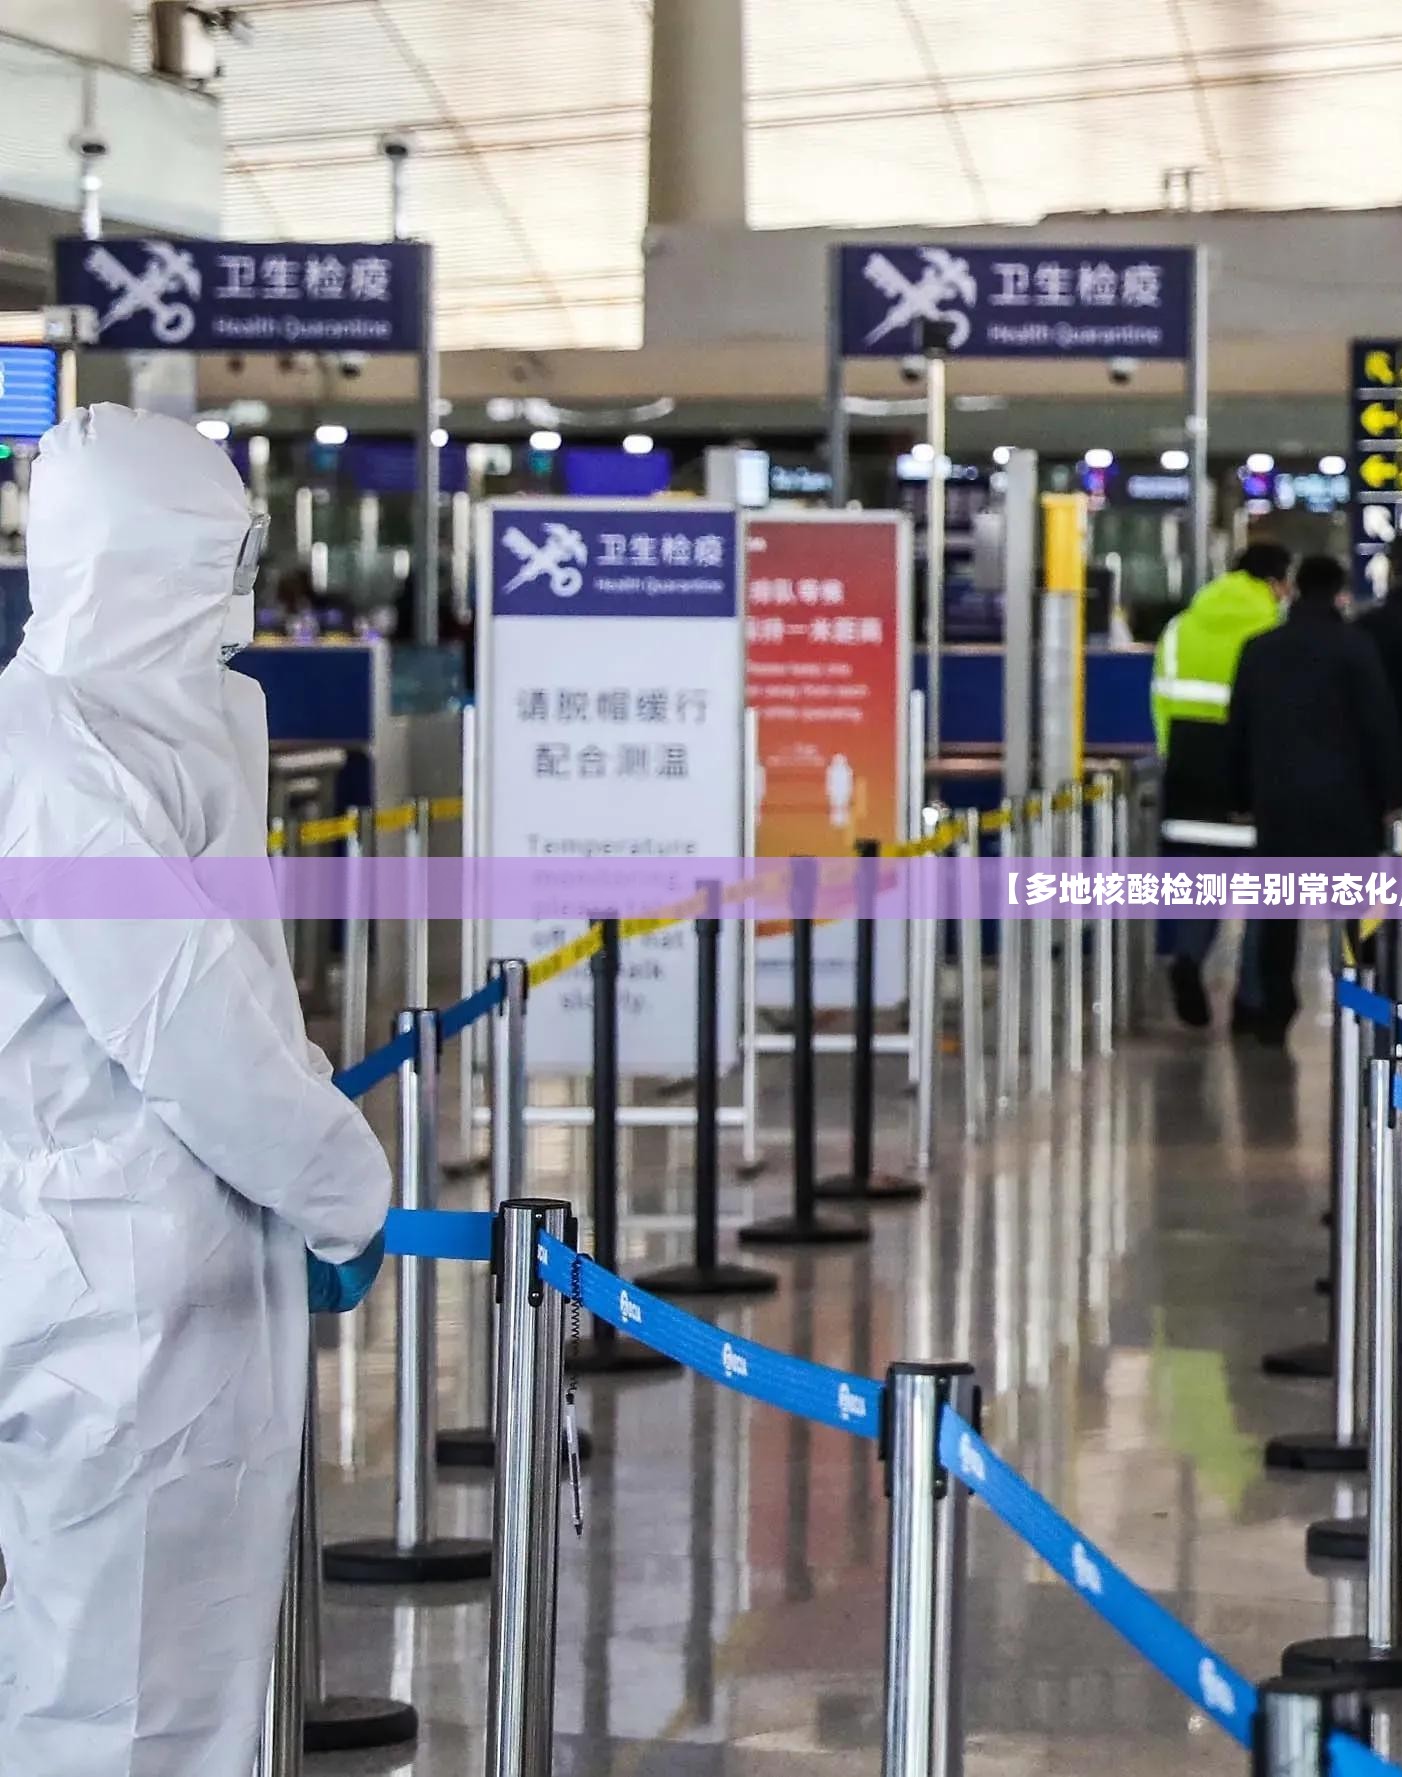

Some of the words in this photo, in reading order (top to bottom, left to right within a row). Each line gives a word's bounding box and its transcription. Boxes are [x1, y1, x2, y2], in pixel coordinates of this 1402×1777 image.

[214, 254, 392, 301] 卫生检疫
[988, 261, 1164, 307] 卫生检疫
[597, 532, 724, 567] 卫生检疫
[517, 688, 707, 722] 请脱帽缓行
[535, 742, 688, 779] 配合测温
[527, 834, 696, 857] Temperature
